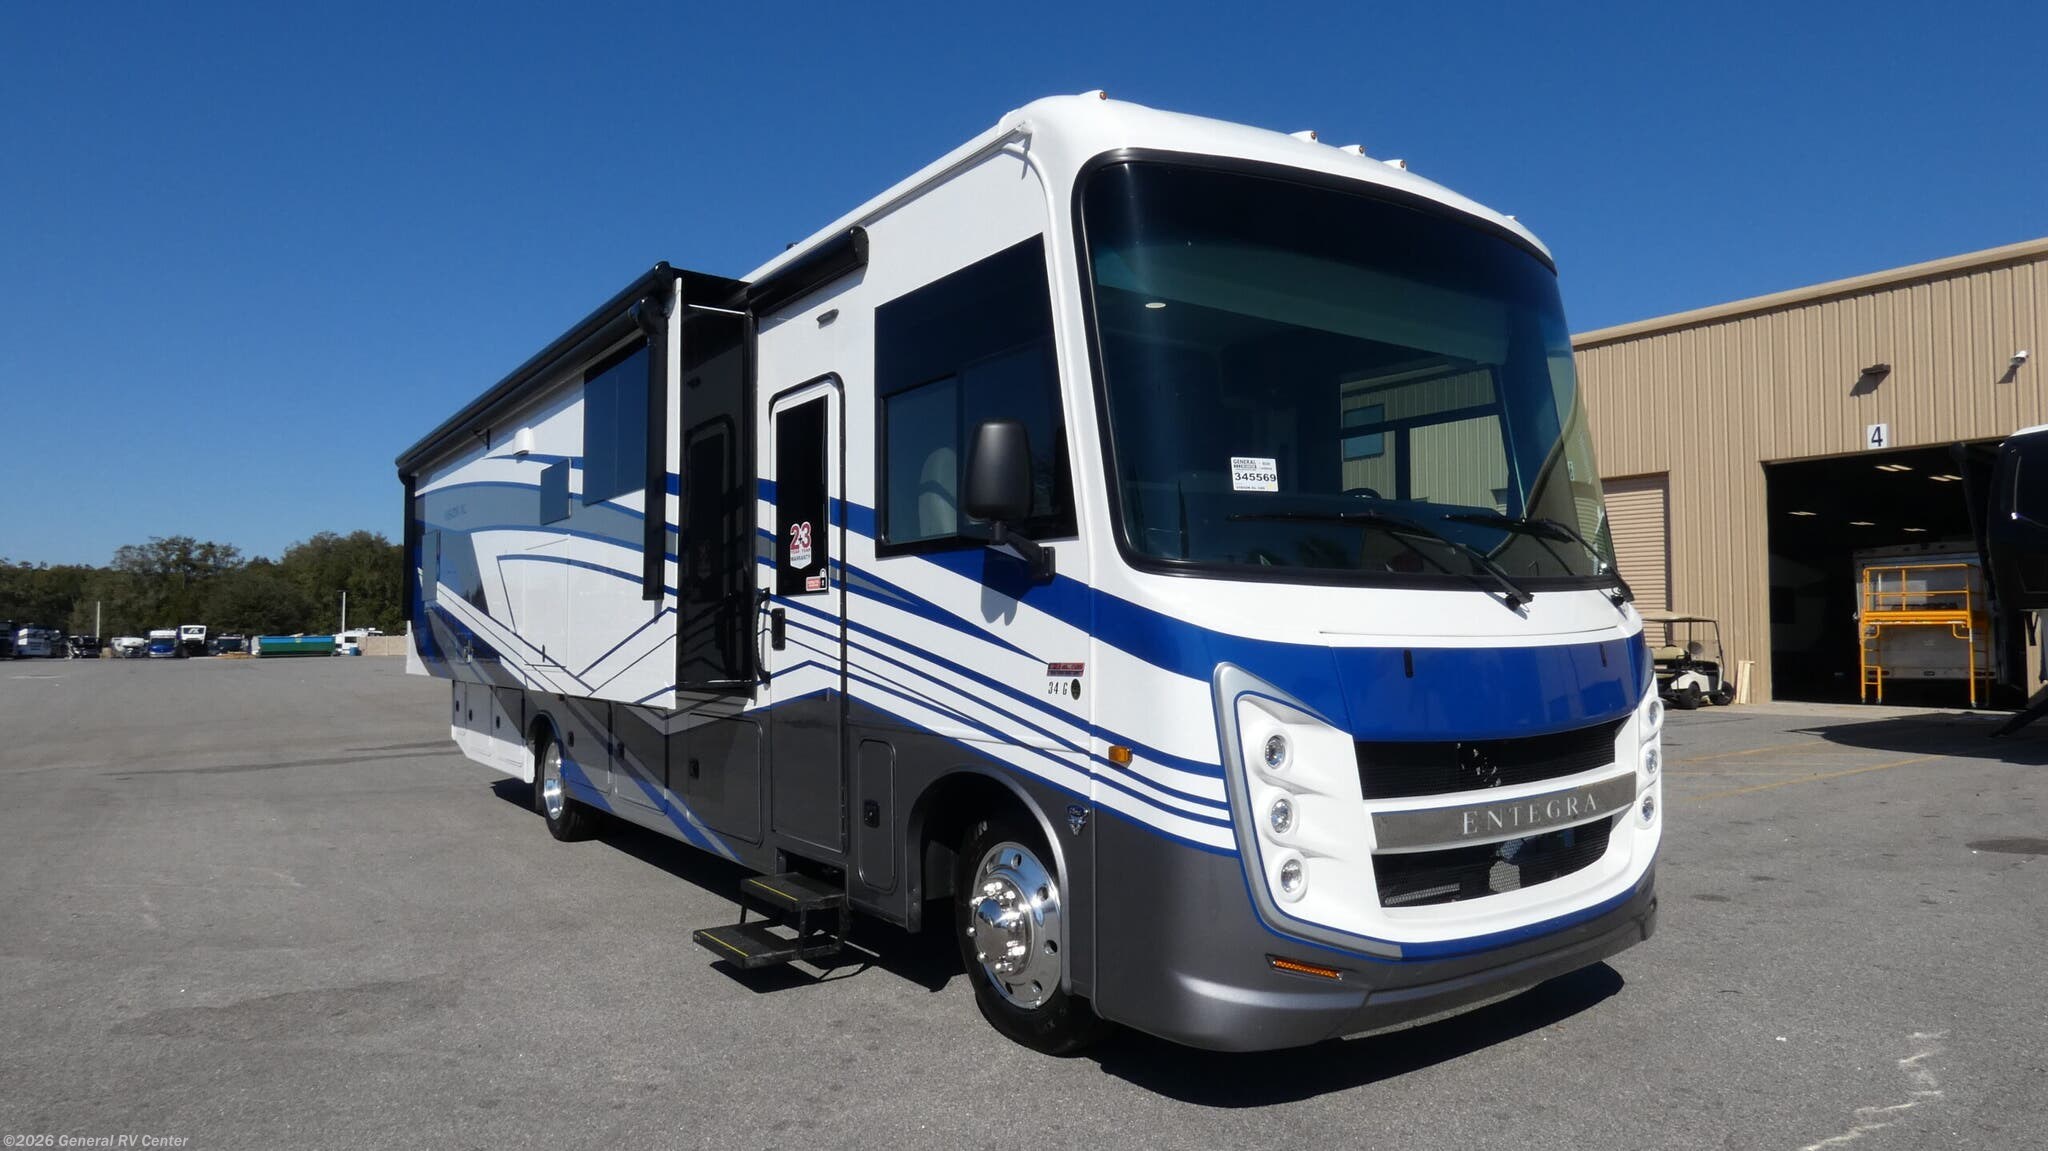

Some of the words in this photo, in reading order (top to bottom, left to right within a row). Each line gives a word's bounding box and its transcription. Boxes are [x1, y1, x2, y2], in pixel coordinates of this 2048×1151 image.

[1871, 426, 1883, 447] 4
[1234, 473, 1277, 482] 345569
[1048, 681, 1059, 695] 34
[1462, 793, 1598, 835] ENTEGRA
